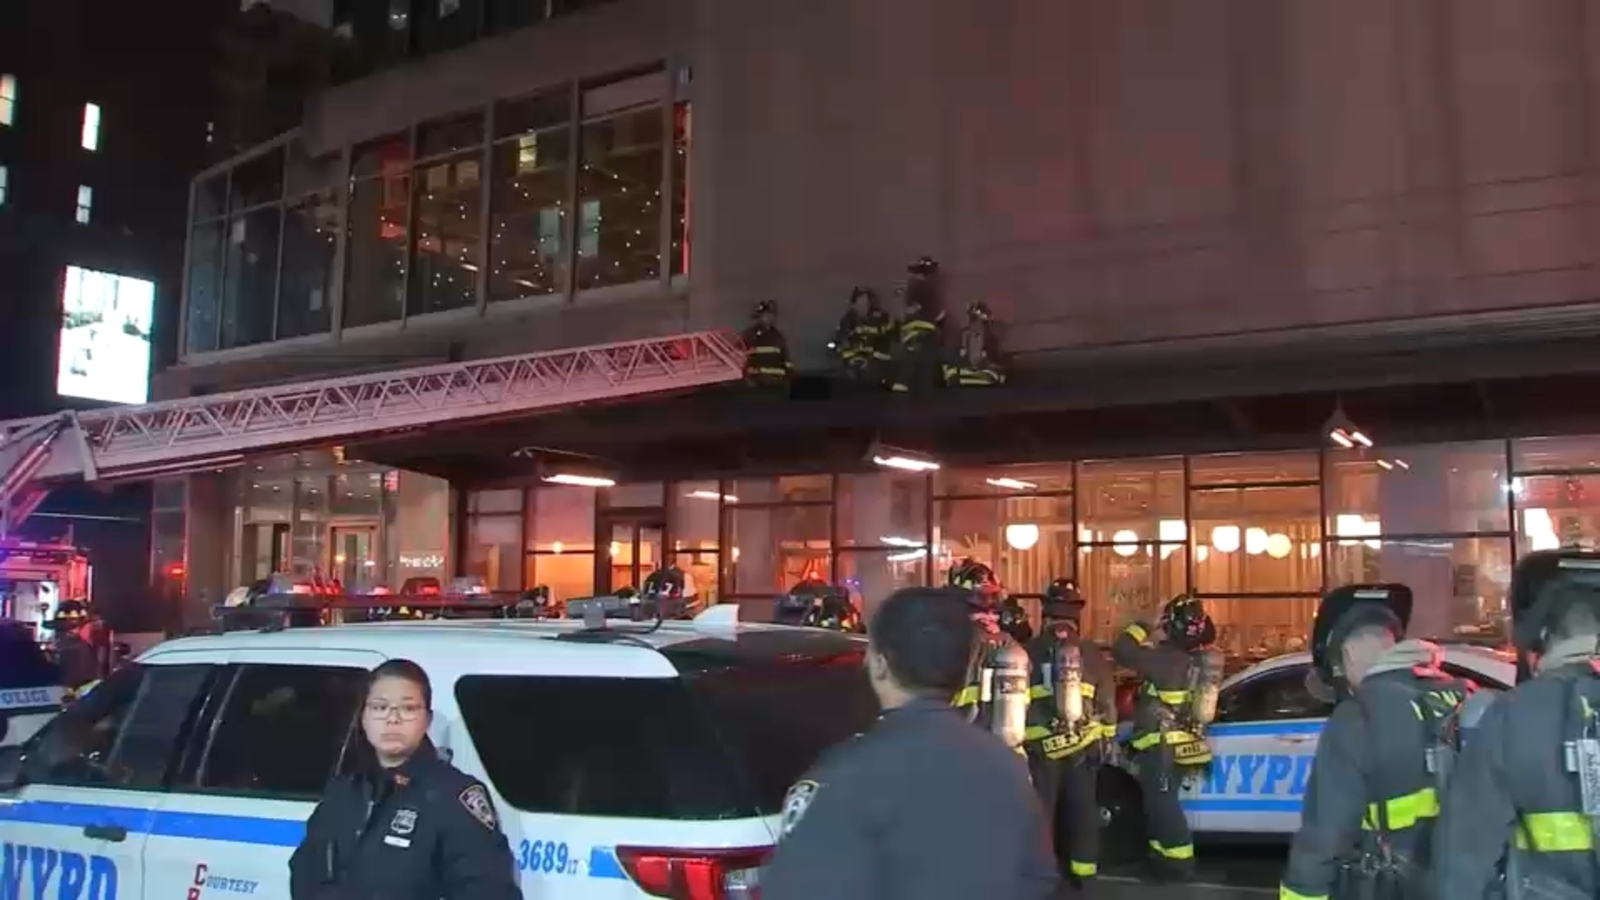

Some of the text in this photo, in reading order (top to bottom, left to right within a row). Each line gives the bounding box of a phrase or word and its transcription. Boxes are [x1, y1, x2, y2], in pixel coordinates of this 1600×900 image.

[0, 689, 51, 706] OLICE
[0, 842, 119, 900] NYPD
[519, 839, 569, 874] 3689
[194, 863, 259, 894] COURTESY
